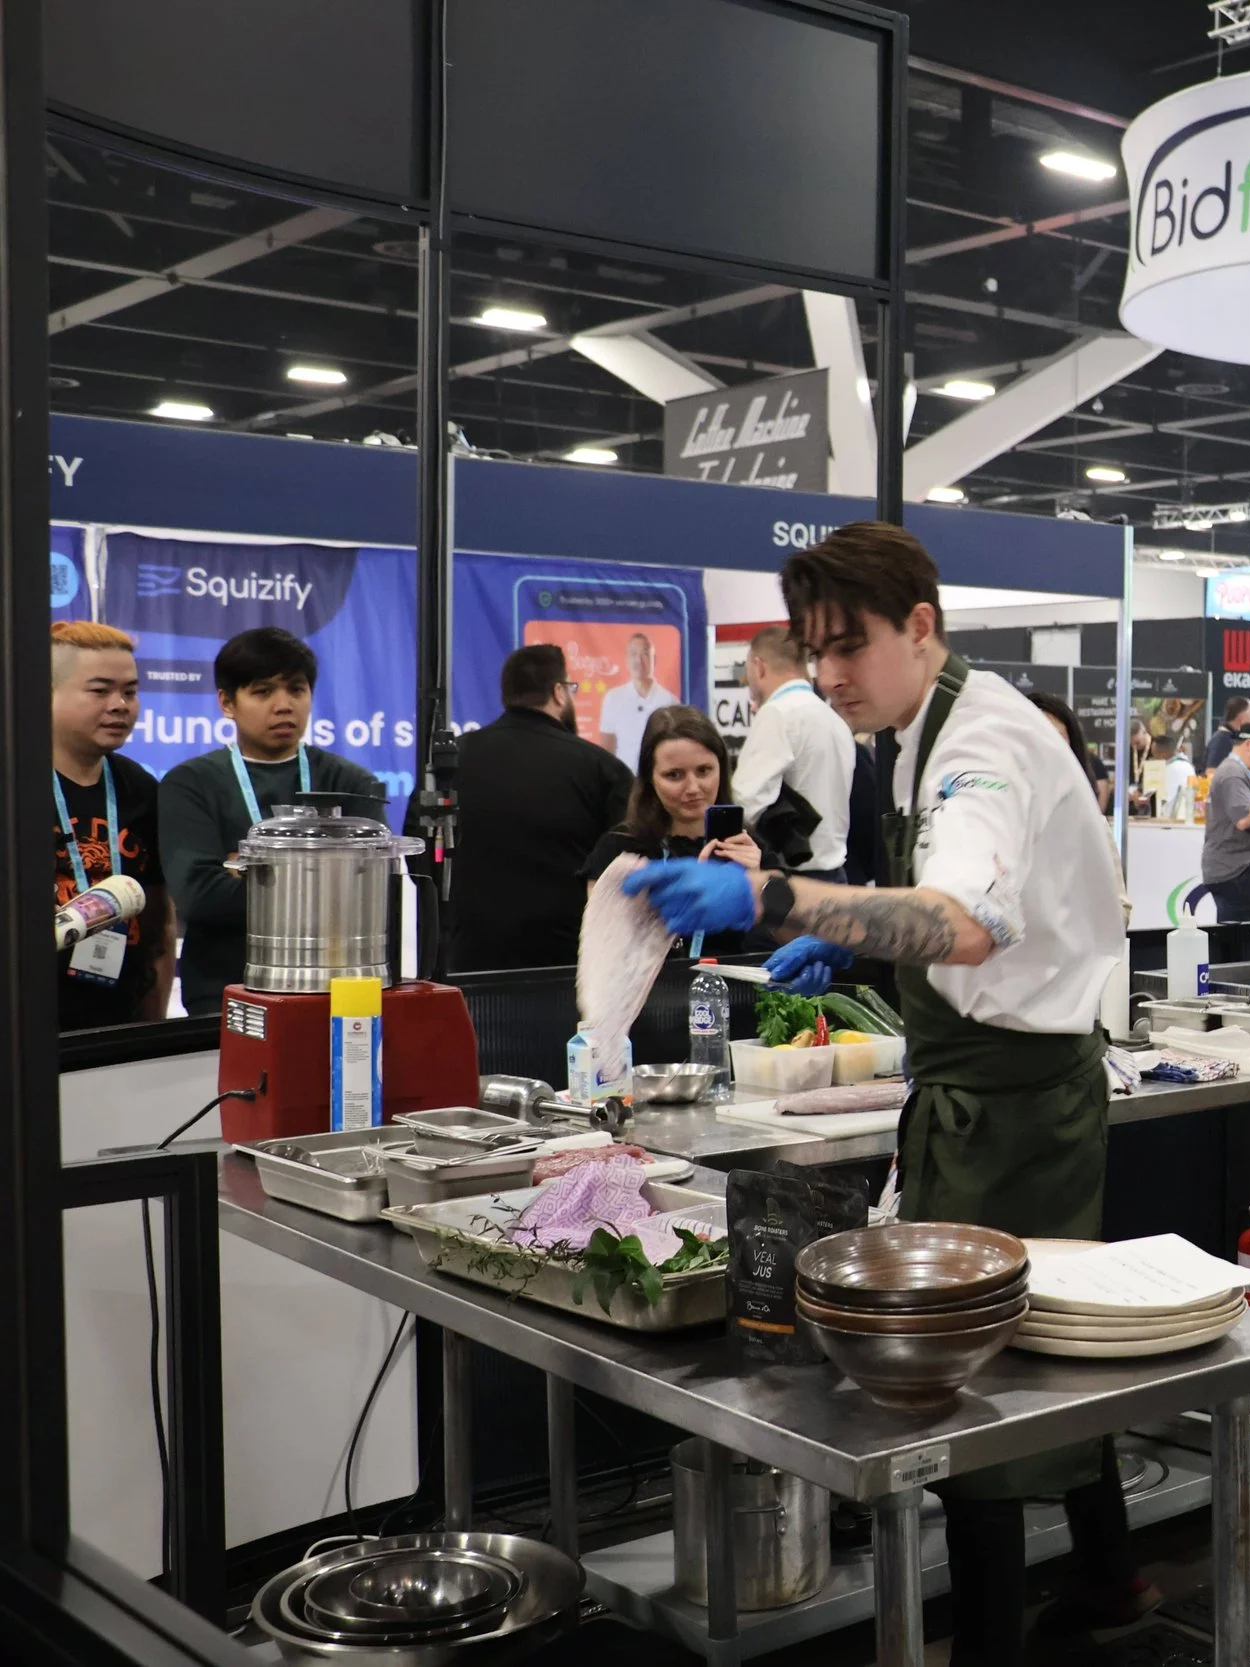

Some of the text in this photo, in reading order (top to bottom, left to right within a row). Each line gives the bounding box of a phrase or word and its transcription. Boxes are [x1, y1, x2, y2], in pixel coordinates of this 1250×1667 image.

[185, 567, 312, 611] Squizify
[147, 670, 202, 682] TRUSTED BY
[345, 711, 385, 746] of
[753, 1249, 777, 1266] VEAL
[752, 1264, 773, 1279] JUS
